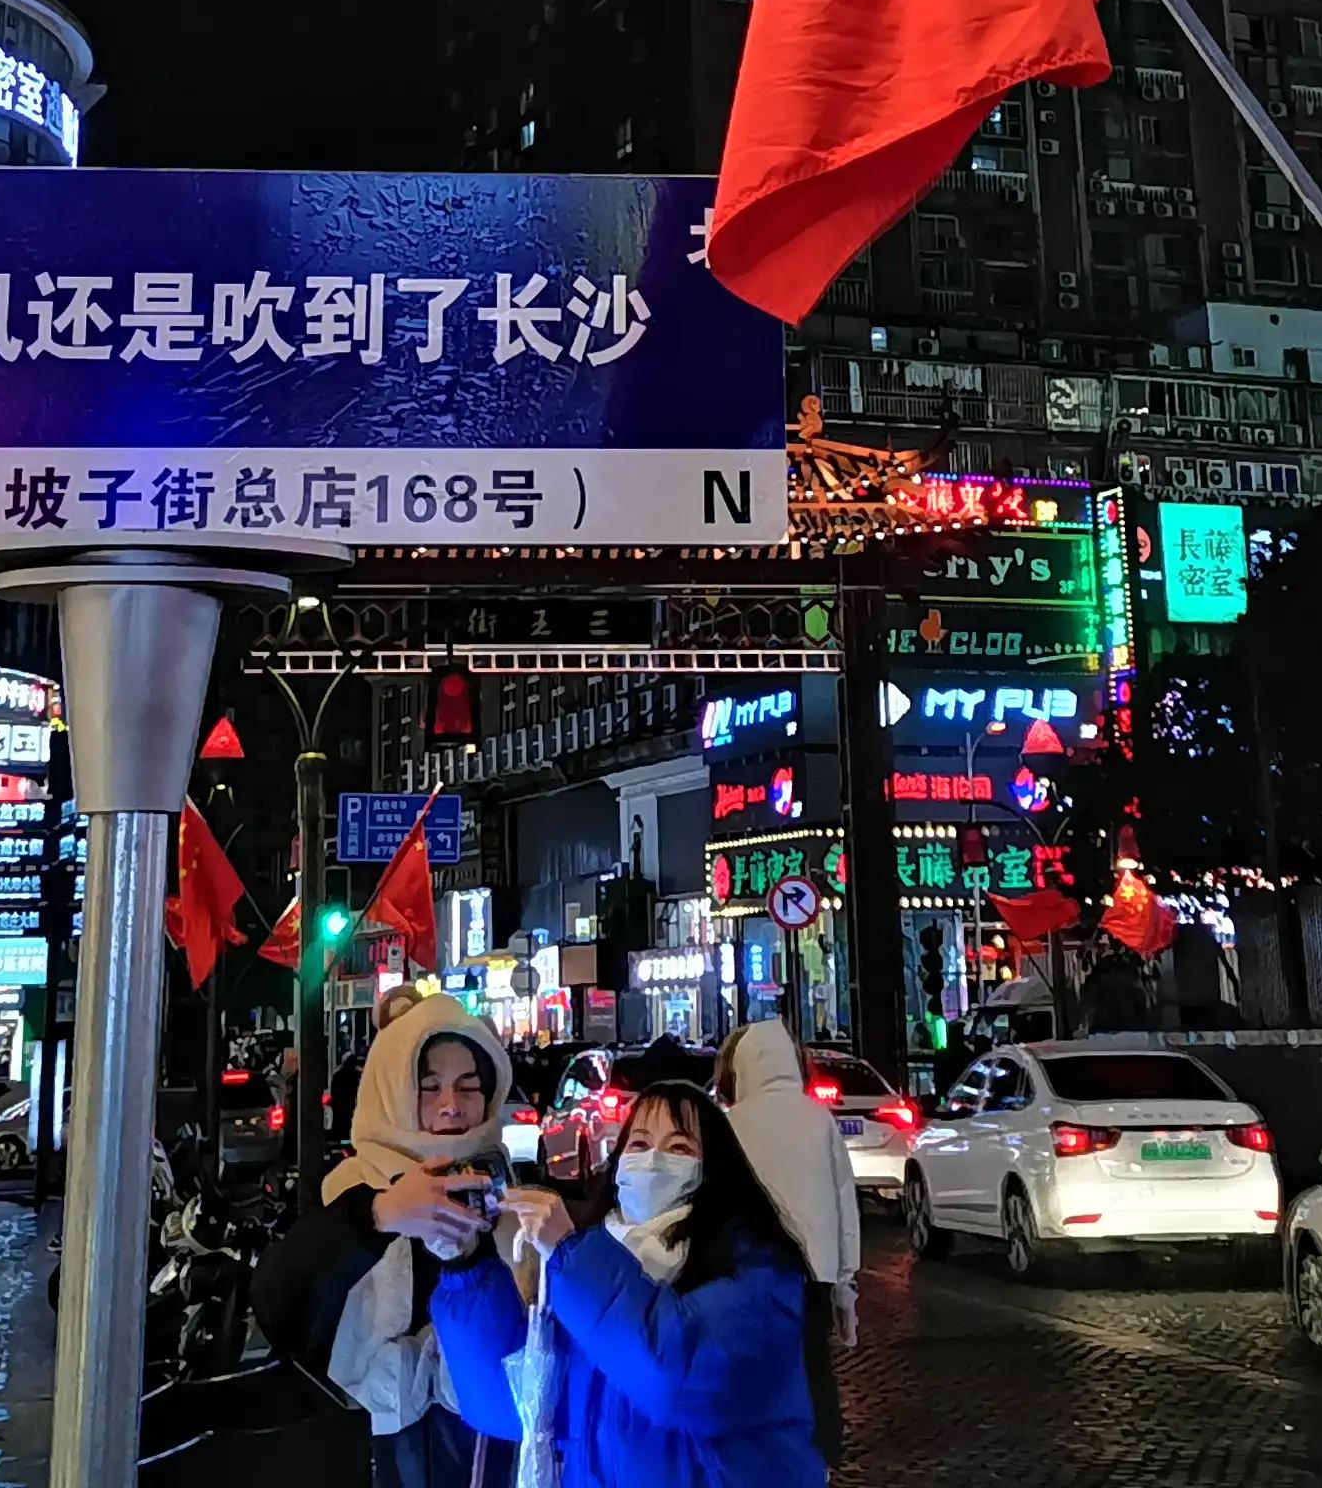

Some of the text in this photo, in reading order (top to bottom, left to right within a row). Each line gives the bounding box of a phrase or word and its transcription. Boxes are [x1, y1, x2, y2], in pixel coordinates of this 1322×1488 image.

[701, 470, 752, 525] N
[1178, 564, 1235, 597] 密室
[924, 687, 986, 721] MY
